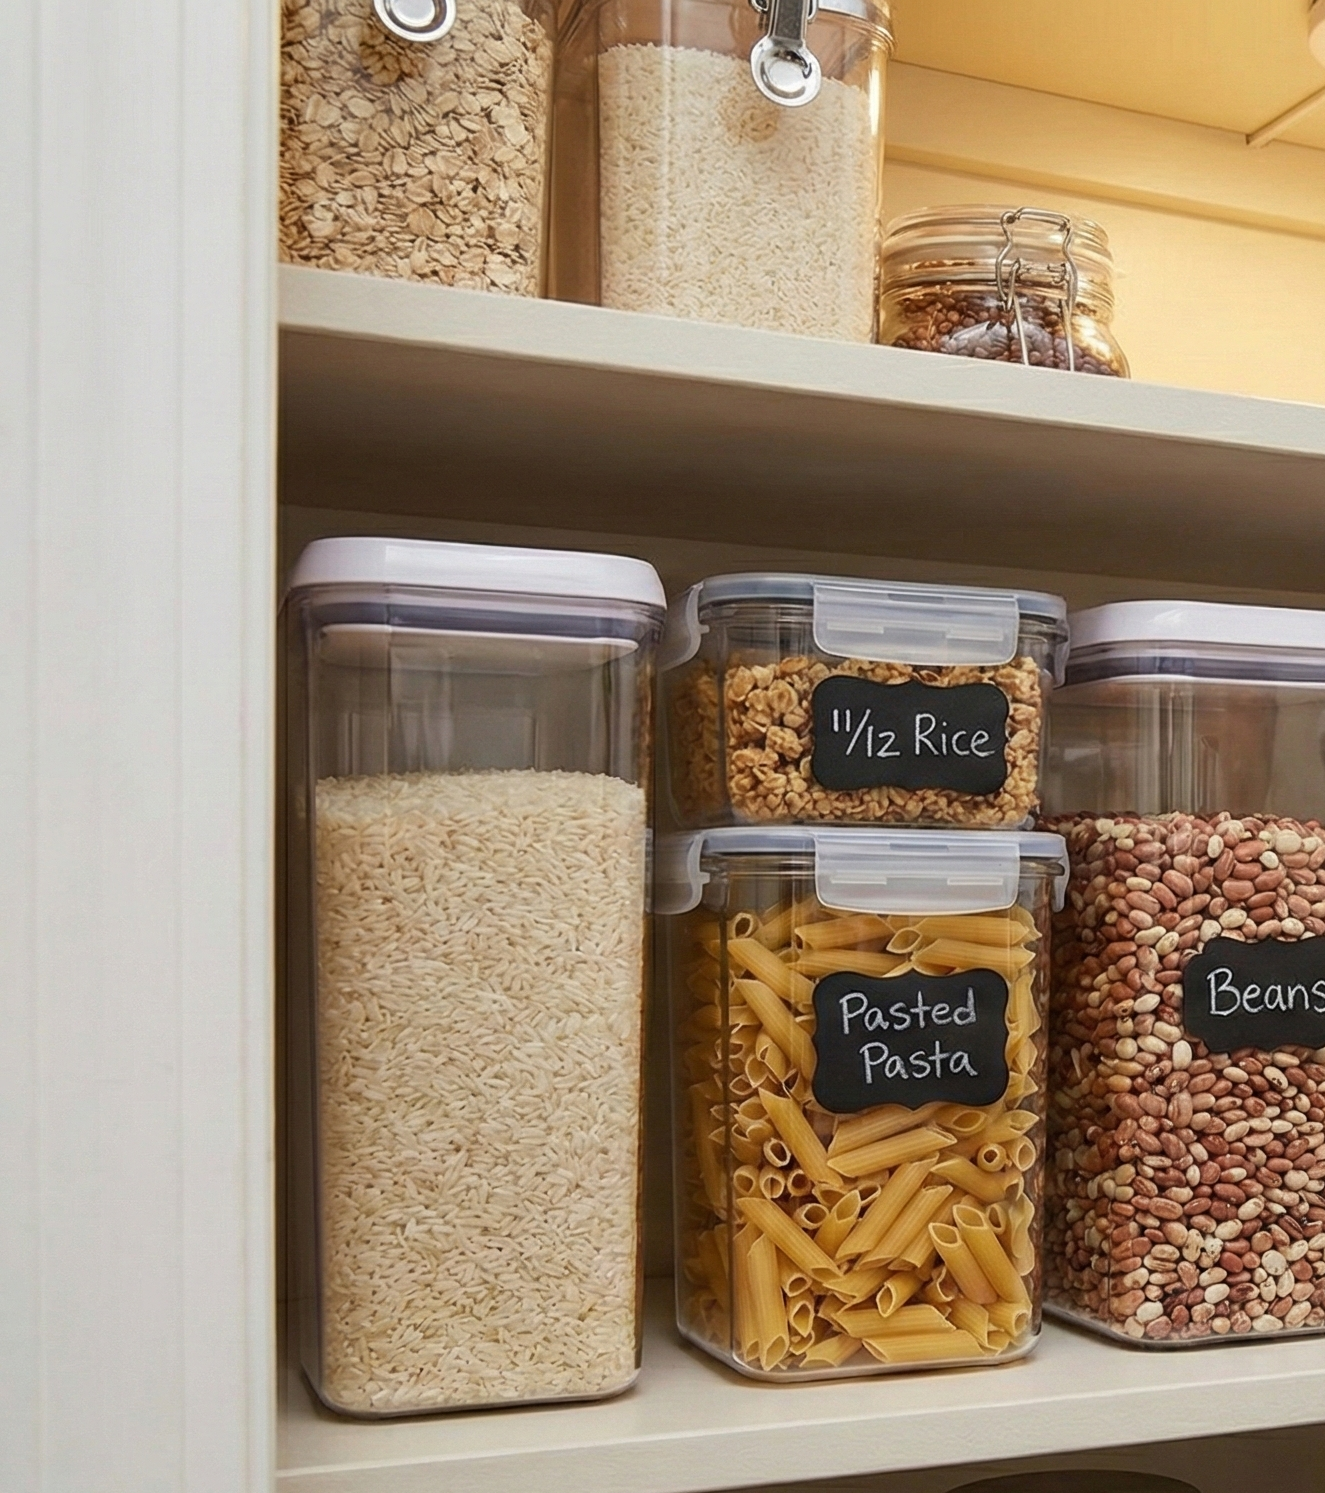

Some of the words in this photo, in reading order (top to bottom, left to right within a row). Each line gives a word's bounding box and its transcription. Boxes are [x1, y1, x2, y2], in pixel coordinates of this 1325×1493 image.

[914, 713, 996, 757] Rice
[839, 986, 977, 1035] Pasted
[859, 1040, 978, 1084] Pasta
